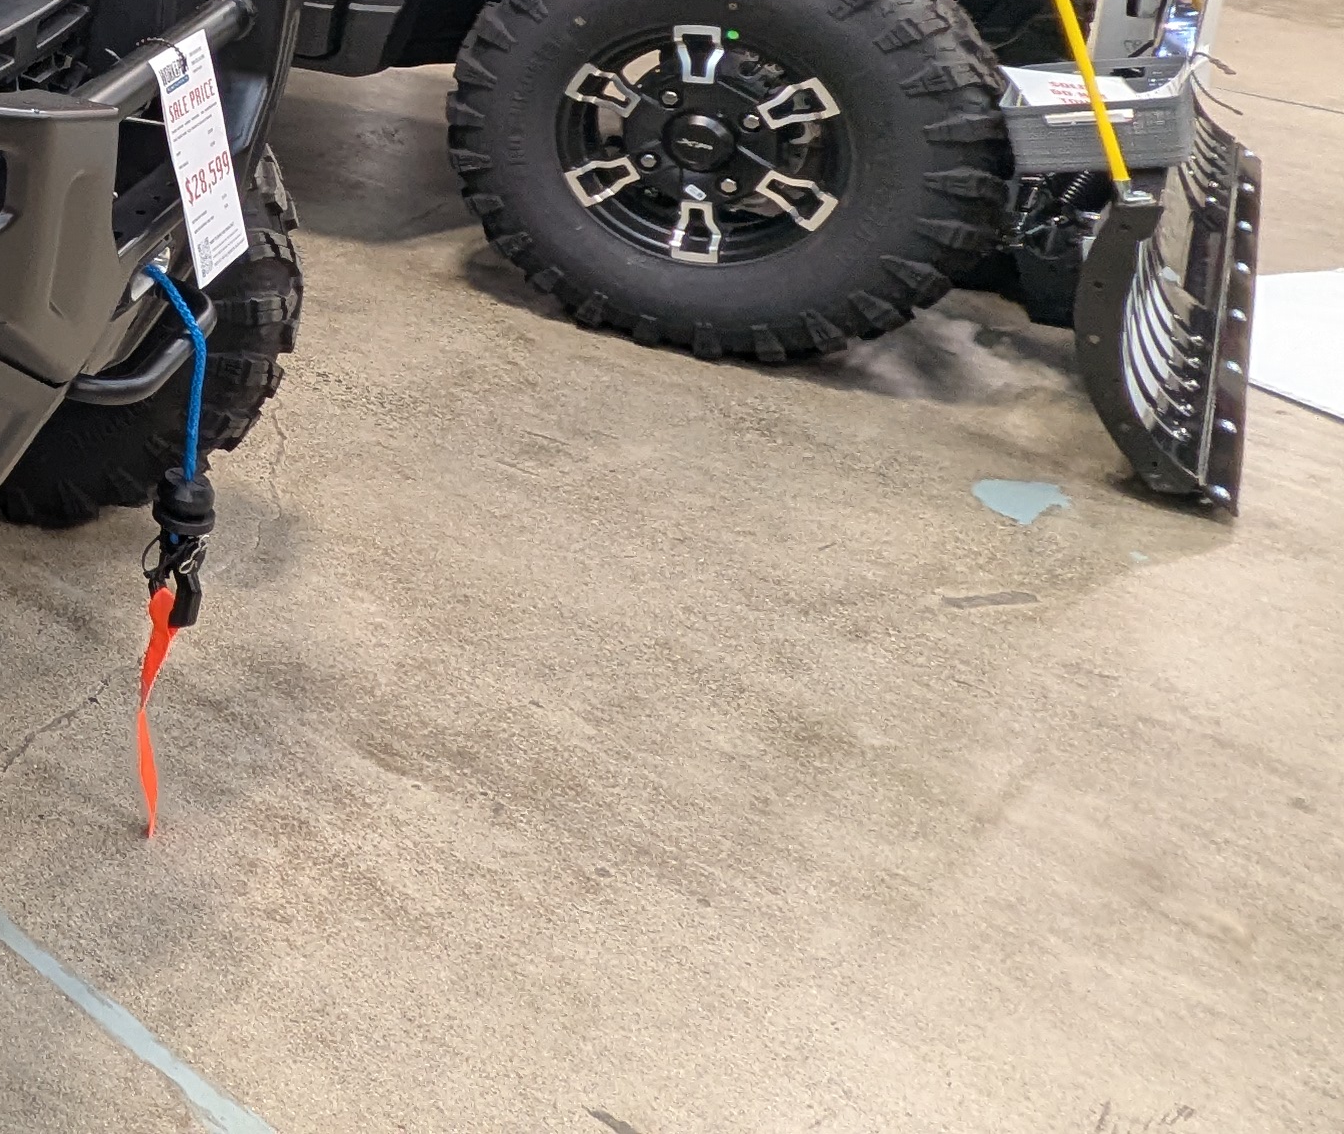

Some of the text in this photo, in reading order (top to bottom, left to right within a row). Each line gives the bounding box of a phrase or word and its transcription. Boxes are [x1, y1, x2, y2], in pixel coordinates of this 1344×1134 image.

[168, 95, 189, 124] SALE
[189, 78, 216, 109] PRICE
[184, 150, 231, 206] $28,599
